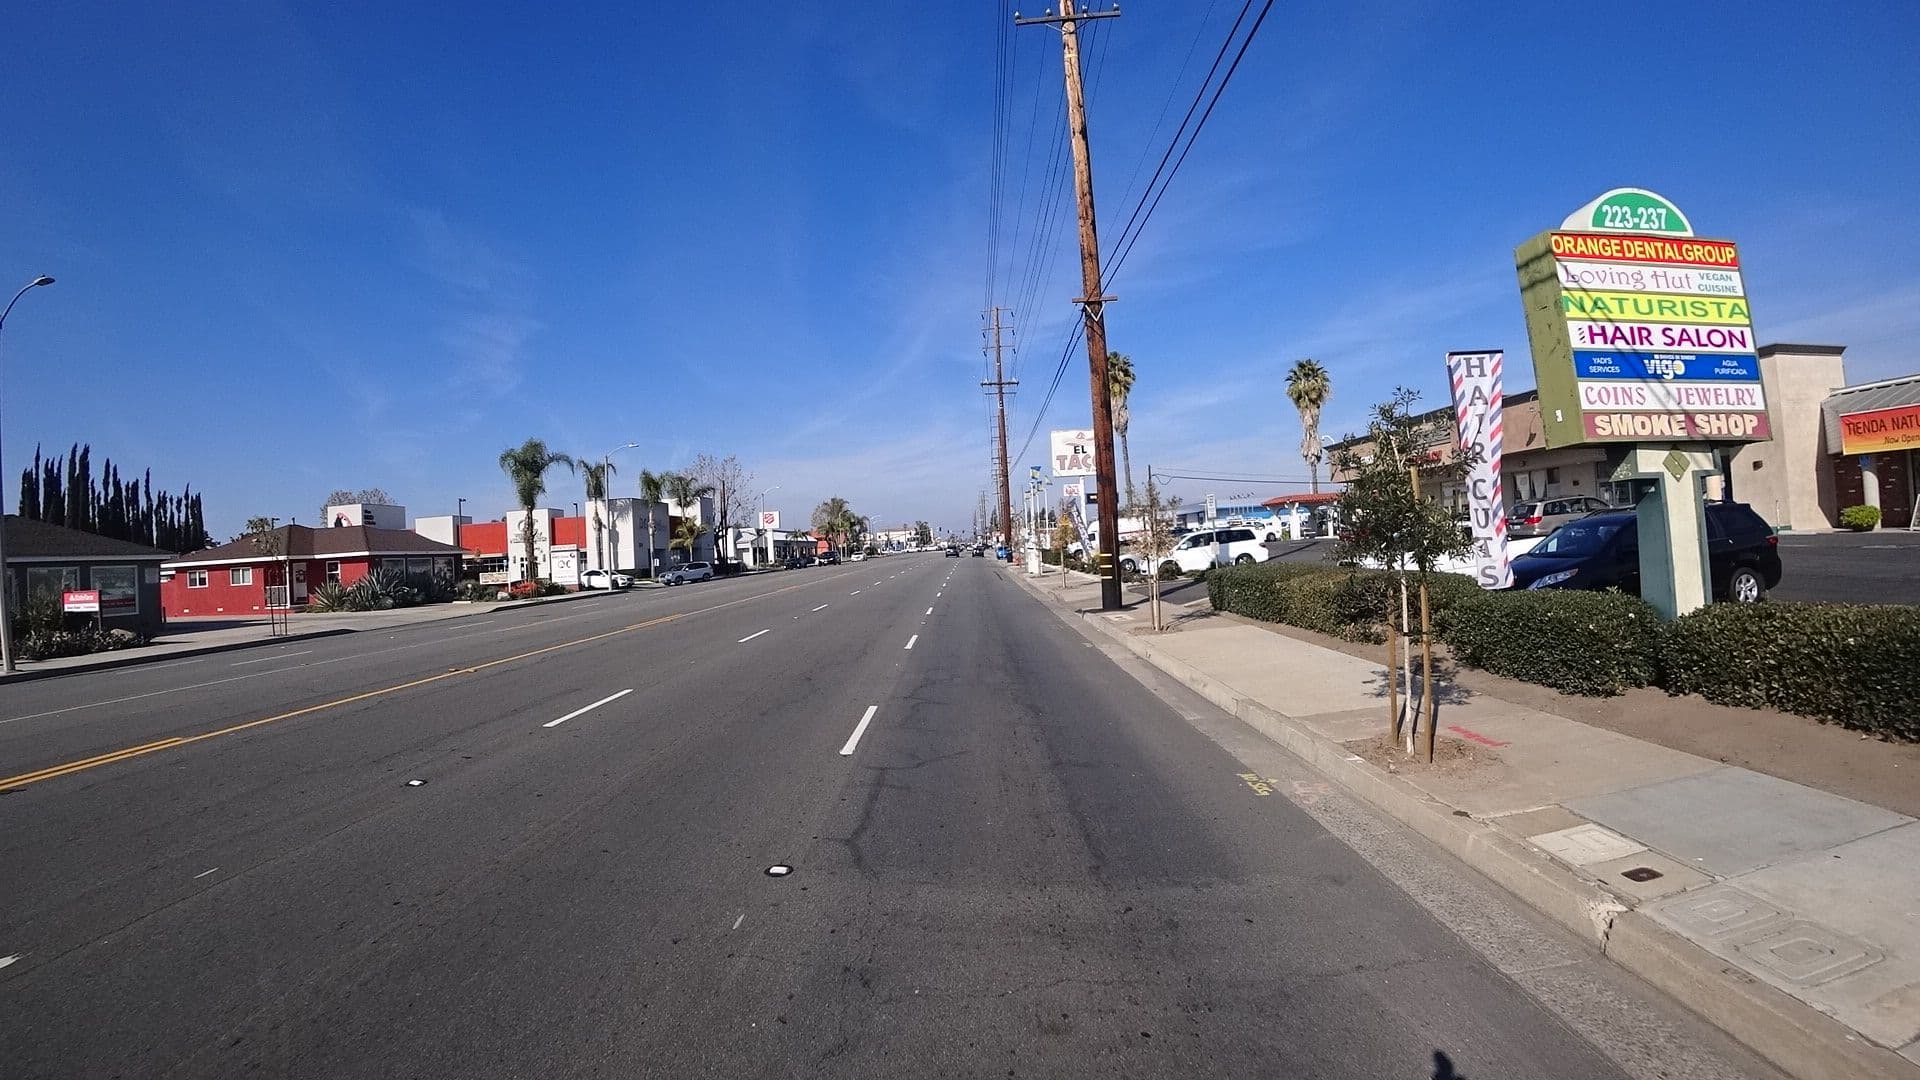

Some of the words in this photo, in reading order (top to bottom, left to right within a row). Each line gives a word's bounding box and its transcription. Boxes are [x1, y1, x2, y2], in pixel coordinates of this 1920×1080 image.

[1602, 204, 1667, 230] 223-237
[1551, 235, 1623, 258] ORANGE
[1624, 240, 1680, 259] DENTAL
[1682, 244, 1737, 264] GROUP
[1563, 264, 1646, 291] Loving
[1651, 268, 1693, 290] Hut
[1698, 272, 1733, 282] VEGAN
[1697, 284, 1738, 294] CUISINE
[1561, 294, 1749, 319] NATURISTA
[1587, 324, 1655, 347] HAIR
[1662, 327, 1748, 349] SALON
[1588, 364, 1621, 374] SERVICES
[1713, 367, 1748, 376] PURIFICADA
[1721, 359, 1740, 368] AGUA
[1584, 385, 1647, 407] COINS
[1675, 386, 1757, 407] JEWELRY
[1593, 413, 1689, 437] SMOKE
[1695, 413, 1759, 437] SHOP
[1845, 418, 1888, 436] TIENDA
[1073, 444, 1088, 454] EL
[1056, 454, 1097, 470] TAC
